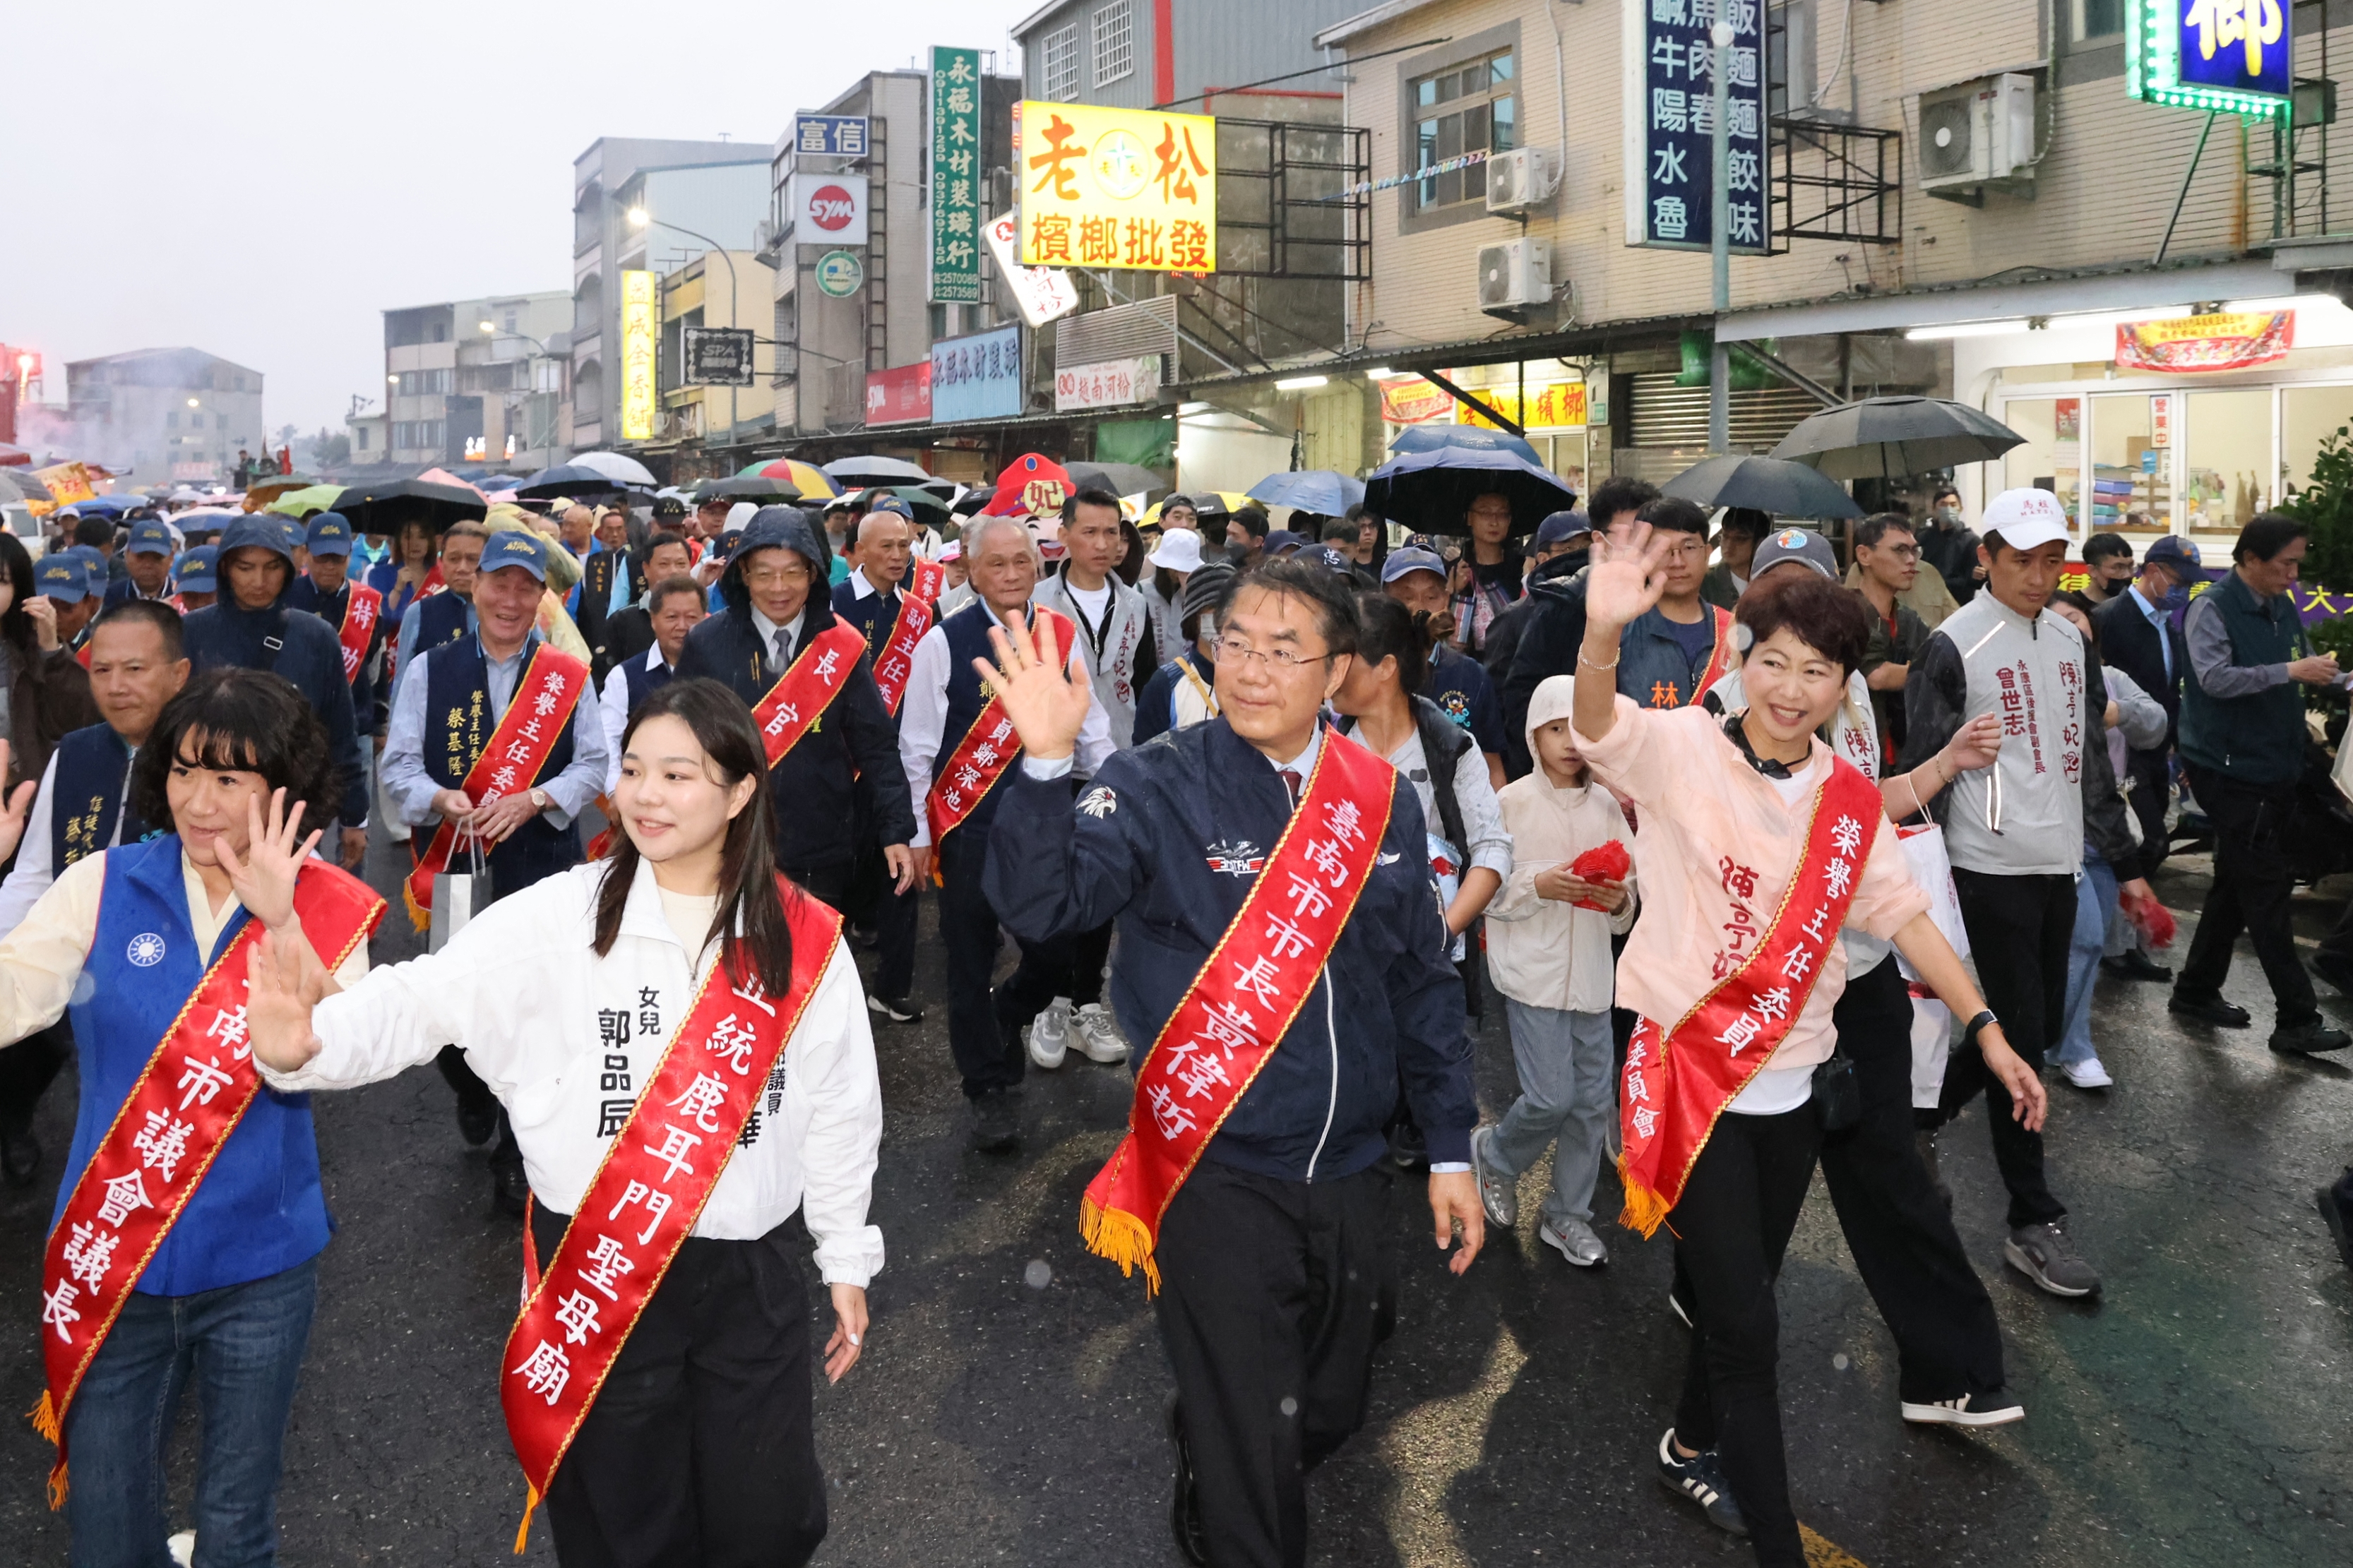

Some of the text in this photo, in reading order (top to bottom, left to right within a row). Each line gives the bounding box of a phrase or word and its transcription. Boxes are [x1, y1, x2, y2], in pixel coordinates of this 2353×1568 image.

[799, 120, 864, 152] 富信
[1653, 88, 1758, 139] 陽春麵
[946, 56, 976, 269] 永福木材裝璜行
[1653, 142, 1759, 192] 水餃
[810, 200, 854, 222] SYM
[1653, 196, 1759, 243] 魯味
[1031, 213, 1208, 269] 檳榔批發
[702, 344, 736, 357] SPA
[1079, 372, 1131, 403] 越南河粉
[2155, 399, 2167, 446] 營業中
[1028, 481, 1060, 512] 妃
[1650, 680, 1680, 709] 林
[1995, 666, 2026, 736] 曾世志
[2017, 659, 2047, 774] 永康區後援會副會長
[2058, 661, 2080, 747] 陳亭妃
[446, 707, 467, 777] 蔡基隆
[1712, 813, 1863, 1058] 榮譽主任委員
[1146, 797, 1366, 1142] 臺南市市長黃偉哲
[638, 986, 661, 1036] 女兒
[42, 978, 253, 1344] 南市議會議長
